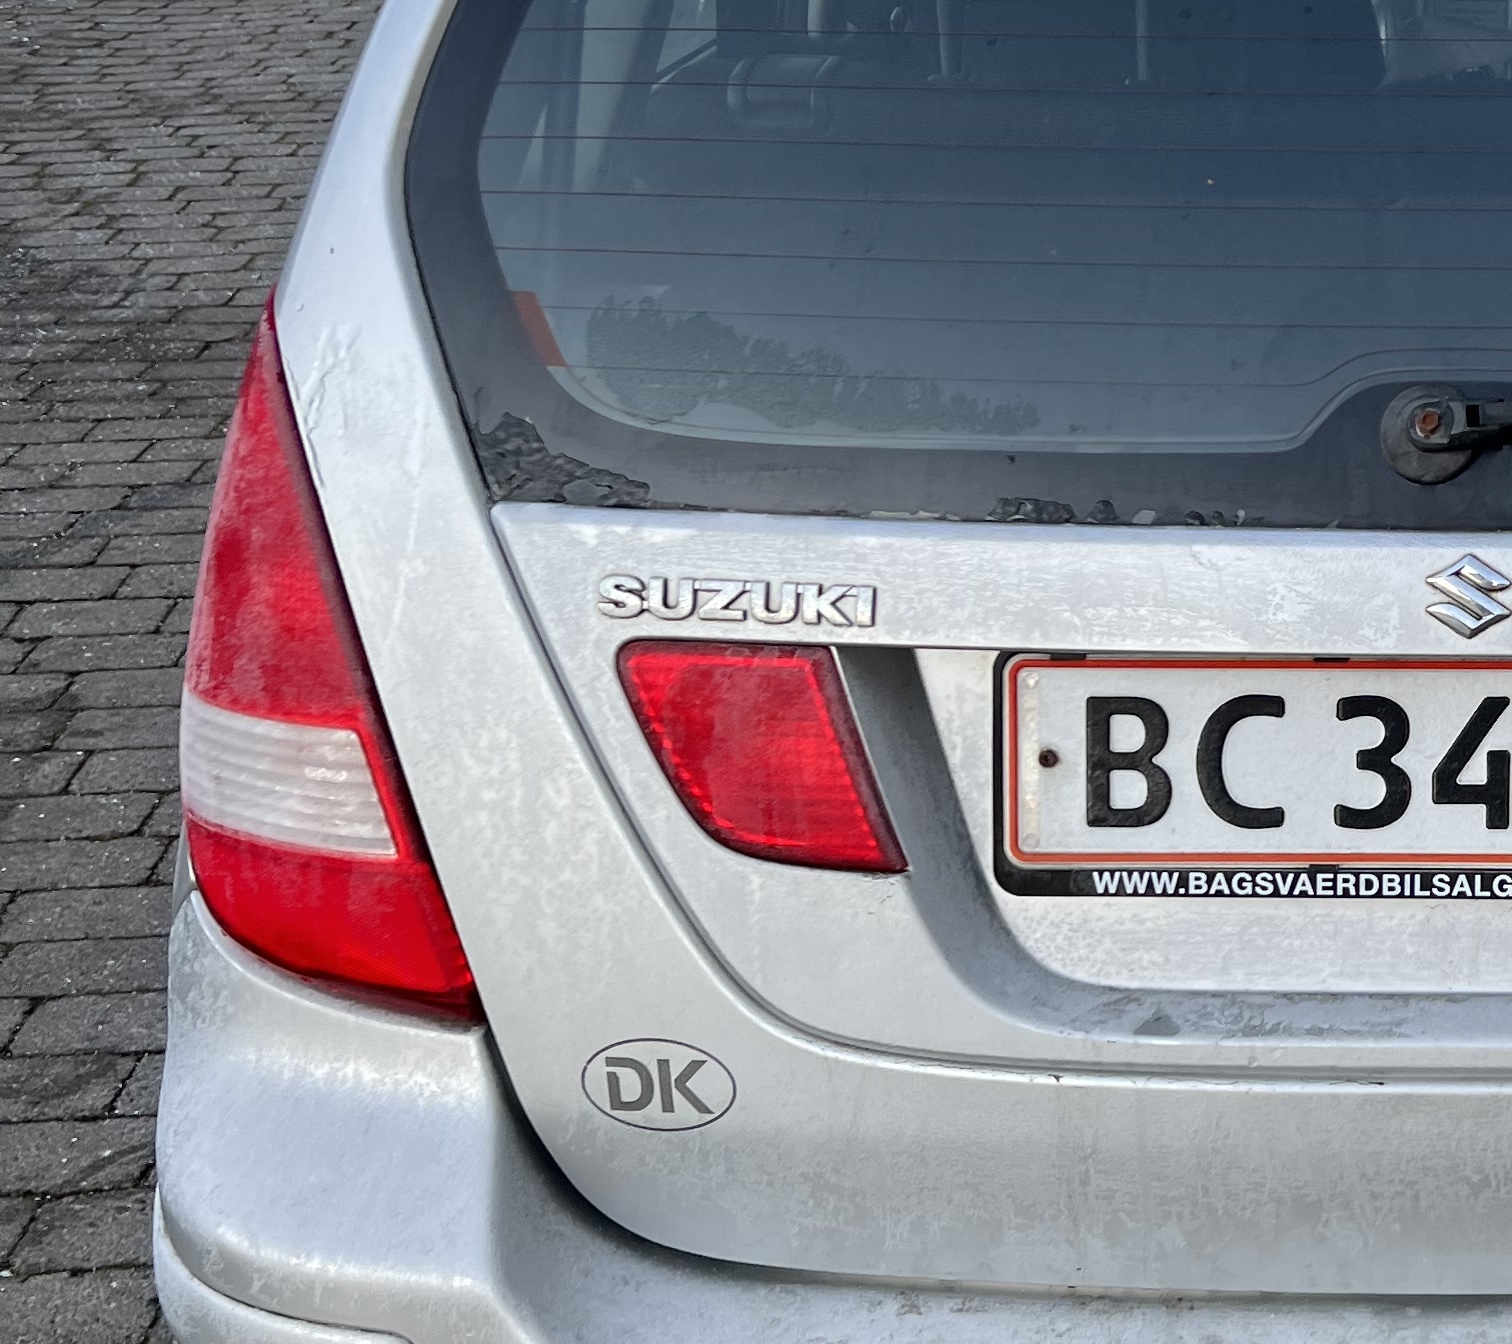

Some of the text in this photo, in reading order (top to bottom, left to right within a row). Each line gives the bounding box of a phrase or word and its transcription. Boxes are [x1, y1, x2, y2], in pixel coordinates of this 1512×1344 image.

[597, 573, 878, 628] SUZUKI
[1086, 694, 1285, 829] BC
[1334, 694, 1512, 830] 34
[605, 1056, 715, 1115] DK
